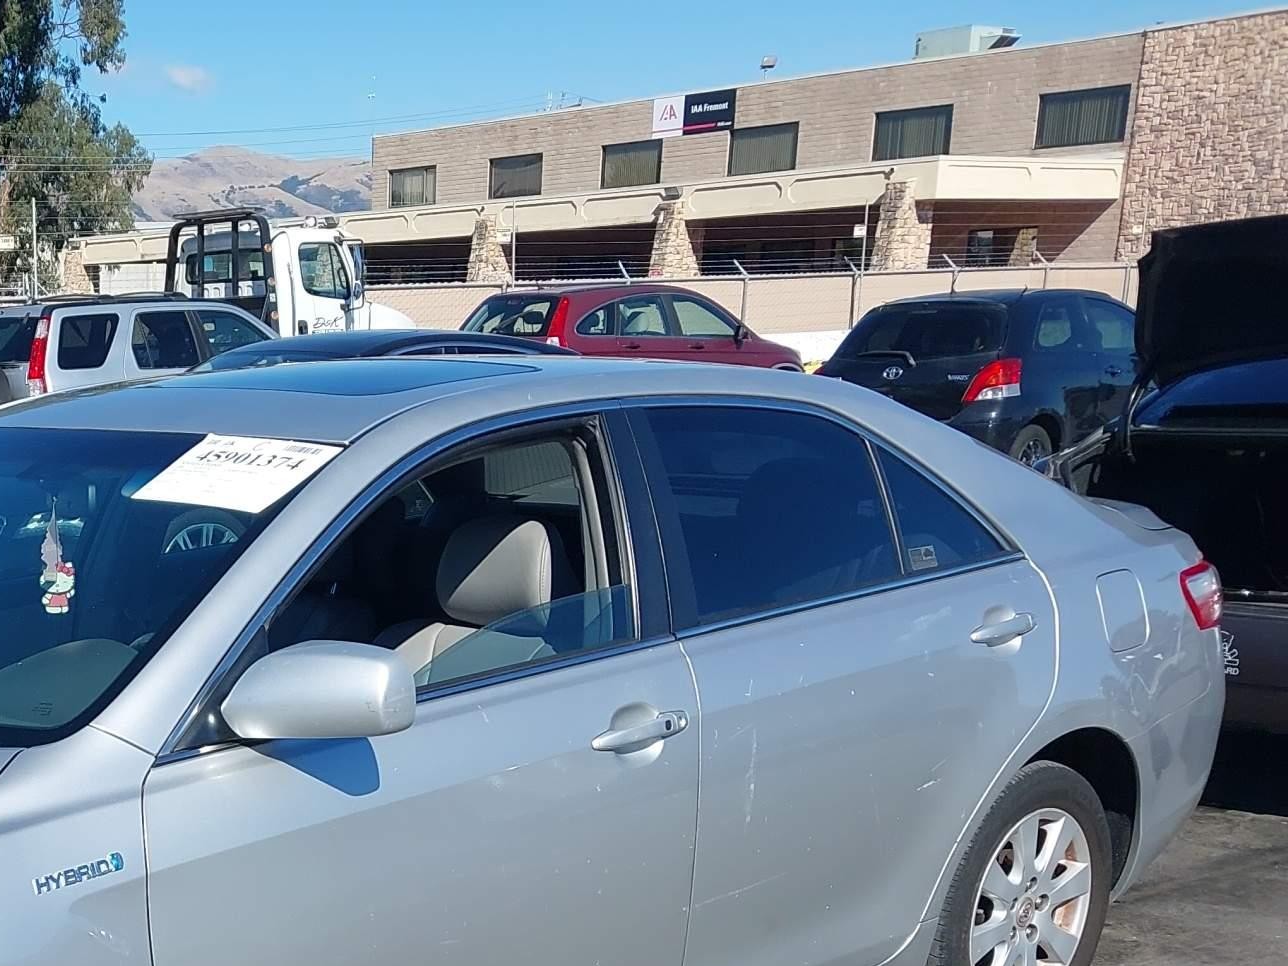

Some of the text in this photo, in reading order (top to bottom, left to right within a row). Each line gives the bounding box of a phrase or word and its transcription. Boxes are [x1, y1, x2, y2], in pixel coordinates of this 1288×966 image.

[691, 102, 729, 114] IAA Fremont
[196, 450, 306, 471] 45901374
[33, 858, 114, 896] HYBRID
